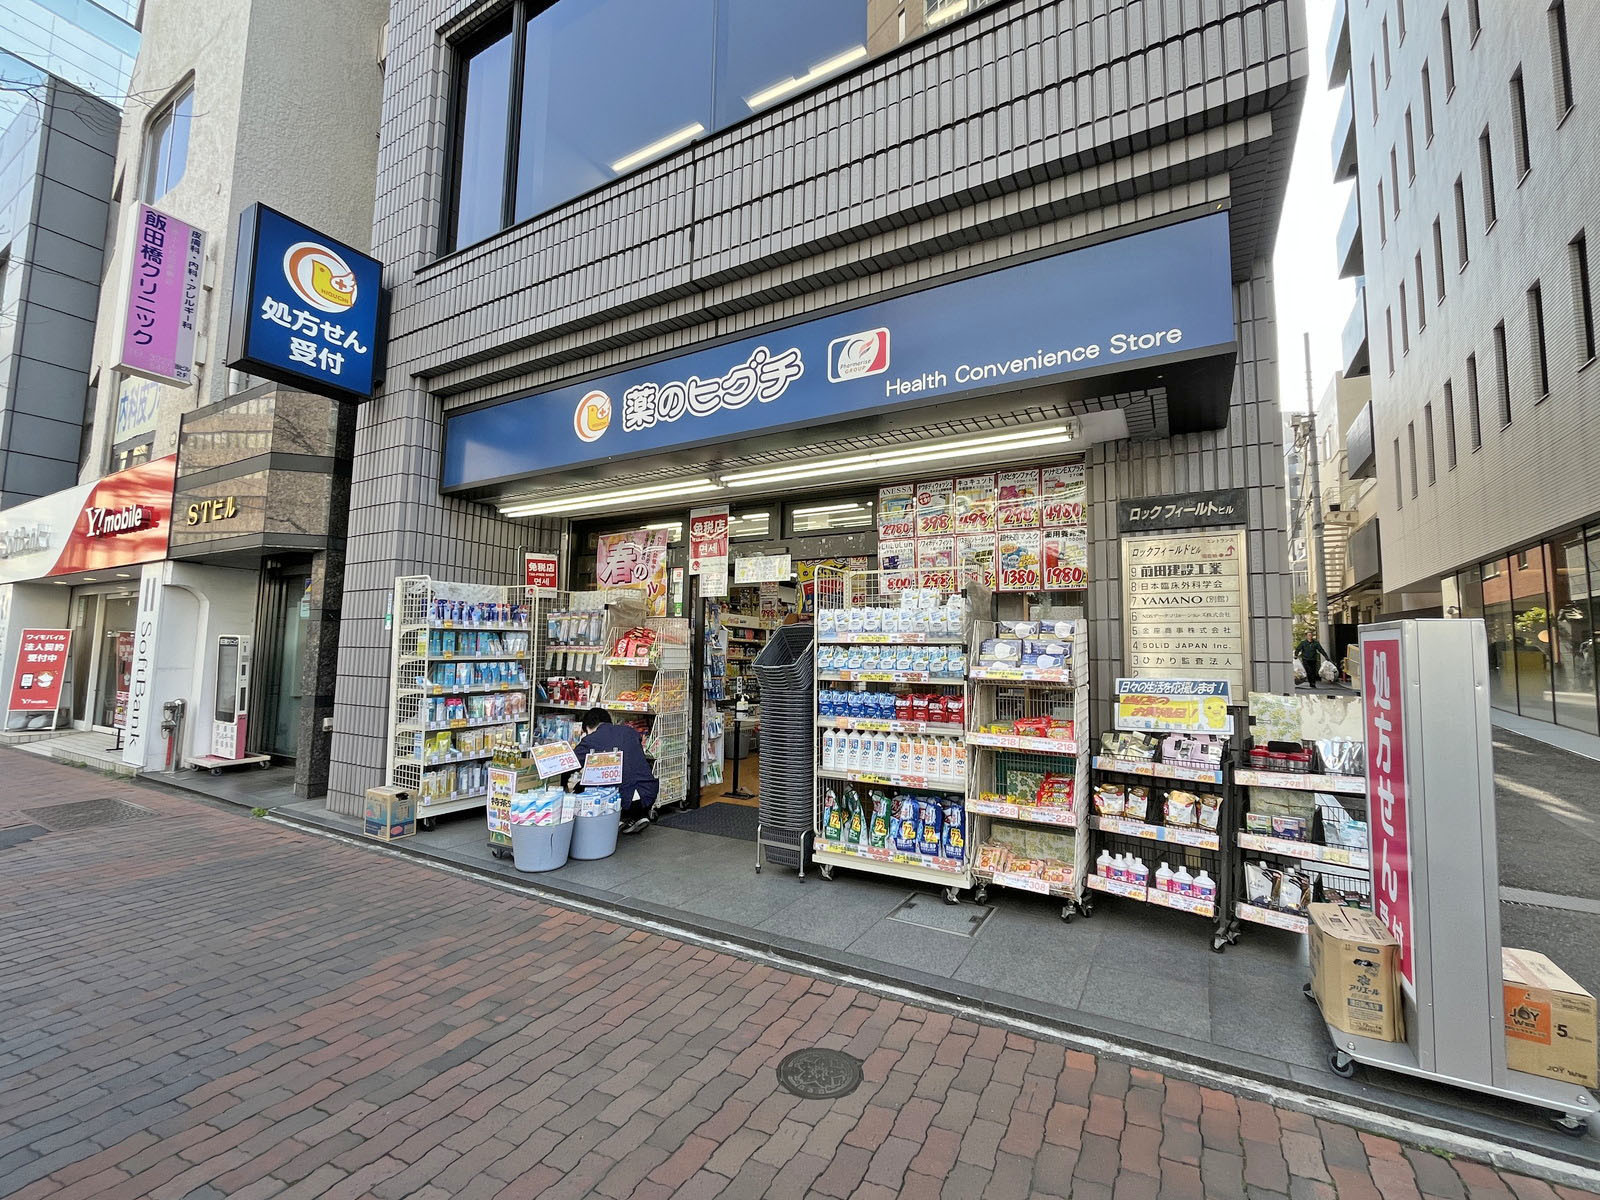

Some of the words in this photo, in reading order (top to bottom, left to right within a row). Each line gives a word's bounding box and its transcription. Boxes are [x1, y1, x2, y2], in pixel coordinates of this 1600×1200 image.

[133, 210, 167, 345] 飯田橋クリニック
[182, 230, 202, 331] 皮膚科・内科・アレルギー科
[321, 288, 349, 304] HIGUCHI
[261, 296, 367, 354] 処方せん
[289, 336, 344, 375] 受付
[886, 370, 947, 397] Health
[955, 344, 1100, 384] Convenience
[1109, 328, 1183, 355] Store
[844, 365, 867, 374] GROUP
[623, 346, 803, 432] 薬のヒグチ
[957, 477, 993, 486] キュキュット
[880, 486, 912, 496] ANESSA
[187, 496, 236, 526] STビル
[85, 504, 142, 537] Y!mobile
[692, 519, 726, 534] 免税店
[920, 514, 950, 531] 398
[882, 522, 910, 535] 2780
[698, 542, 718, 556] 면세
[1132, 544, 1201, 557] ロックフィールドビル
[528, 562, 555, 572] 免税店
[600, 540, 648, 584] 春の
[1003, 569, 1036, 584] 1380
[1046, 567, 1082, 583] 1980
[1131, 567, 1137, 577] 9
[1140, 562, 1223, 578] 前田建設工業
[533, 577, 550, 586] 면세
[1131, 582, 1137, 592] 8
[1141, 580, 1223, 590] 日本臨床外科学会
[1132, 596, 1137, 606] 7
[1141, 595, 1203, 605] YAMANO
[1132, 611, 1138, 621] 6
[1132, 626, 1138, 636] 5
[24, 642, 65, 652] 法人契約
[1132, 641, 1138, 650] 4
[27, 653, 58, 663] 受付中
[1133, 655, 1139, 665] 3
[1142, 657, 1232, 665] ひかり監査法人
[129, 621, 152, 747] SoftBank
[1120, 681, 1225, 694] 日々の生活を応援します！
[1000, 737, 1017, 746] 218
[1056, 742, 1074, 751] 218
[560, 756, 575, 766] 218
[601, 770, 619, 779] 1600
[1373, 649, 1399, 903] 処方せん
[999, 806, 1016, 815] 228
[1055, 814, 1073, 823] 228
[1349, 984, 1380, 995] アリエール
[1509, 1005, 1540, 1022] JOY
[1556, 1024, 1568, 1038] 5
